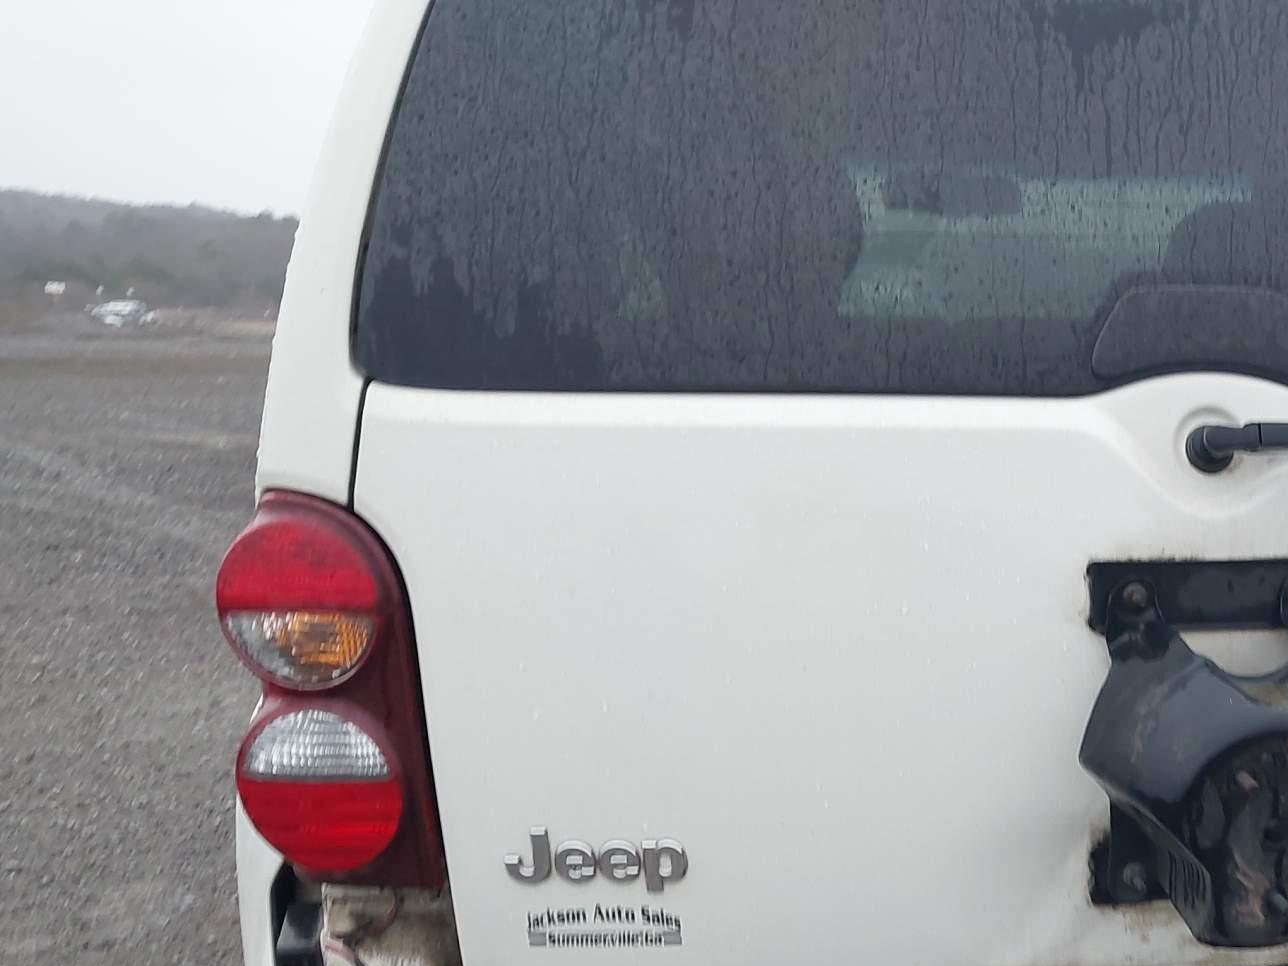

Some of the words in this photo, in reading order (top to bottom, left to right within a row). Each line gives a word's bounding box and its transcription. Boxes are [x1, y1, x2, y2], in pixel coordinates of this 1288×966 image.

[504, 825, 688, 892] Jeep
[527, 907, 587, 930] Jackson
[593, 903, 636, 924] Auto
[640, 904, 682, 930] Sales
